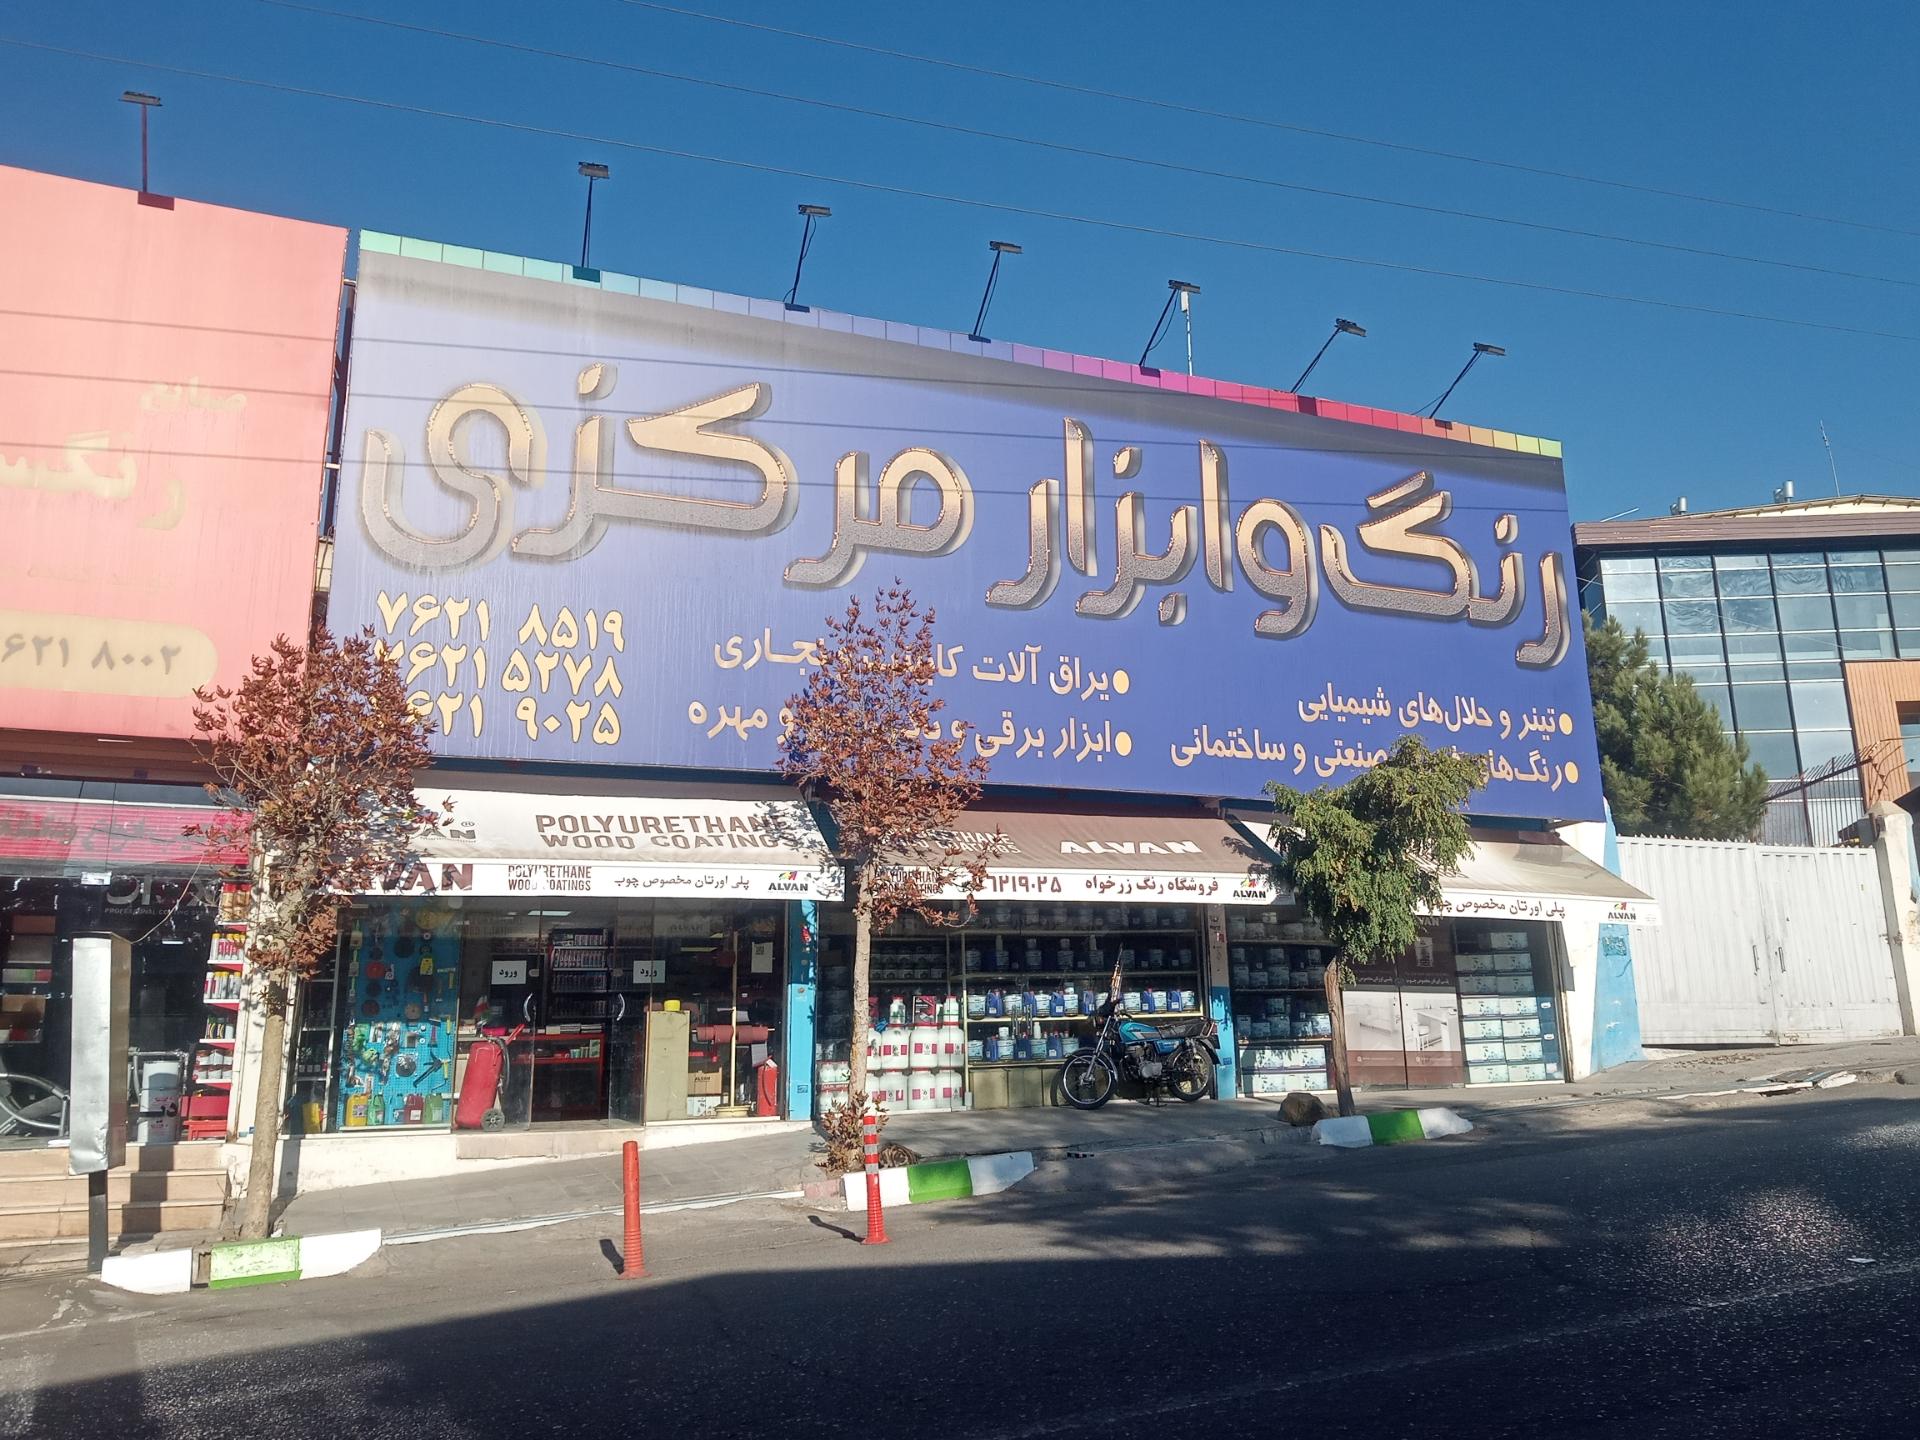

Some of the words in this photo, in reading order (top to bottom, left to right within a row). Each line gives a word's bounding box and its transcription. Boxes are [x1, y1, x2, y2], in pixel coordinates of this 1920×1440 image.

[362, 361, 975, 588] مرکزی
[377, 589, 490, 642] ۷۶۲۱
[518, 603, 625, 653] ۸۵۱۹
[501, 648, 624, 699] ۵۲۷۸
[972, 644, 1042, 686] آلات
[1049, 655, 1110, 701] یراق
[1299, 682, 1392, 725] شیمیایی
[373, 689, 484, 738] ۶۲۱
[516, 696, 622, 745] ۹۰۲۵
[688, 700, 768, 742] مهره
[1500, 709, 1512, 740] و
[1518, 707, 1556, 741] تینر
[975, 710, 1045, 759] برقی
[1053, 717, 1112, 763] ابزار
[1170, 724, 1286, 767] ساختمانی
[1293, 743, 1306, 775] و
[535, 814, 796, 834] POLYURETHANE
[540, 834, 635, 850] WOOD
[650, 832, 799, 850] COATINGS
[1060, 840, 1202, 855] ALVAN
[543, 879, 591, 891] OATINGS
[614, 877, 640, 888] چوب
[642, 876, 692, 889] مخصوص
[731, 875, 750, 891] پلی
[768, 882, 808, 892] ALVAN
[1136, 876, 1164, 895] رنگ
[1168, 877, 1219, 896] فروشگاه
[1233, 890, 1267, 899] ALVAN
[1455, 897, 1506, 913] مخصوص
[1546, 902, 1566, 919] پلی
[1608, 911, 1637, 921] ALVAN
[499, 967, 518, 978] ورود
[639, 967, 658, 977] ورود
